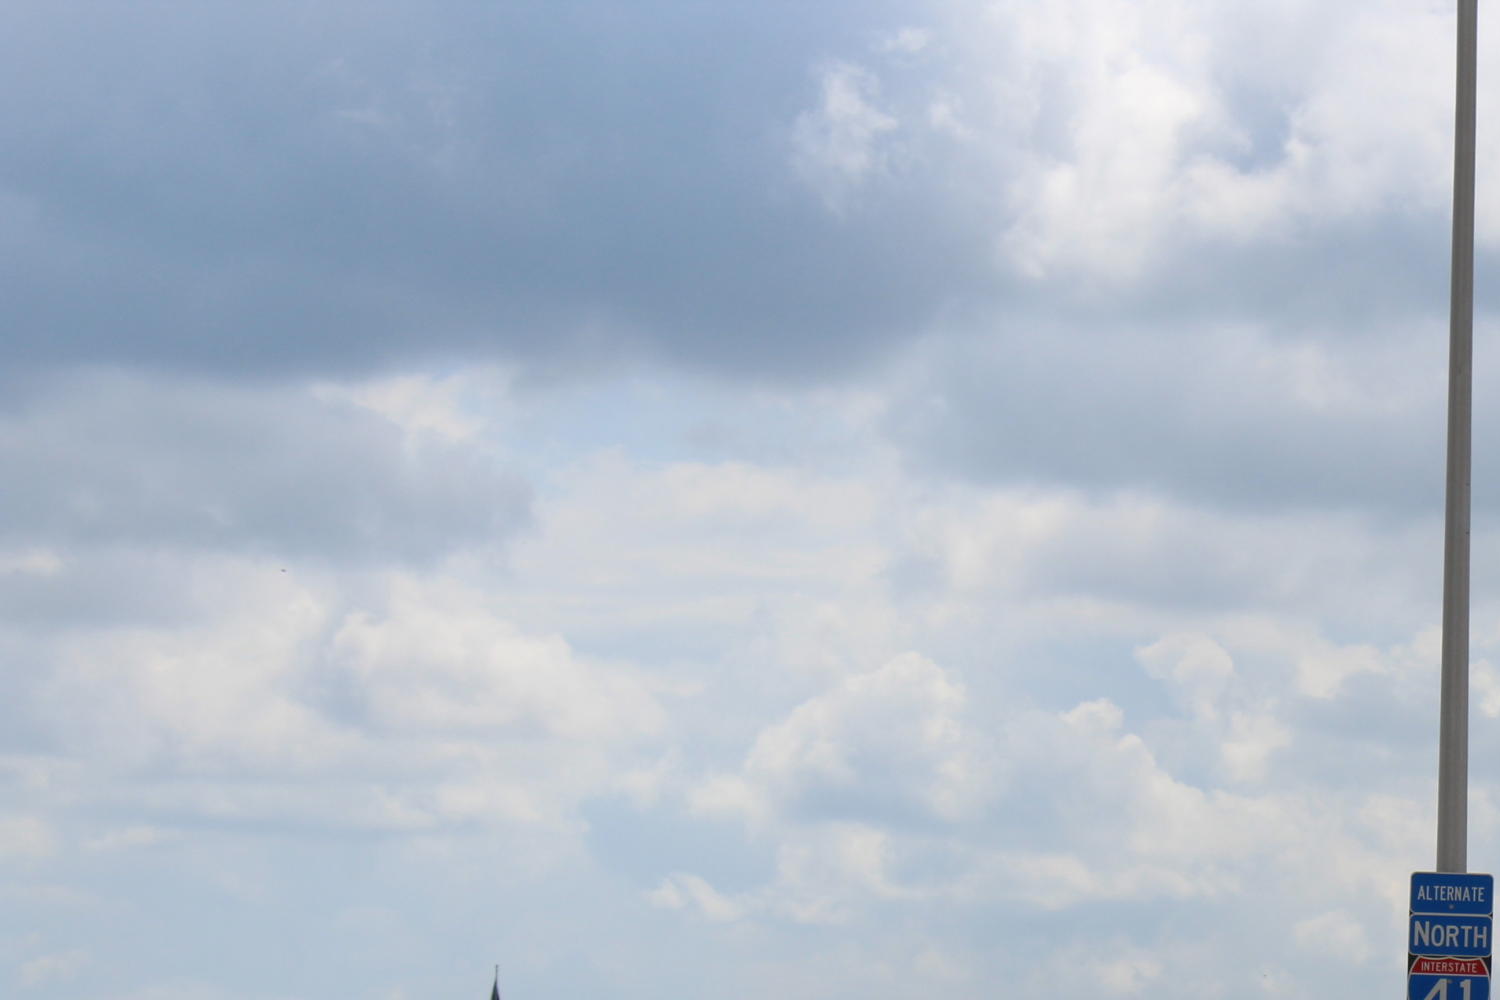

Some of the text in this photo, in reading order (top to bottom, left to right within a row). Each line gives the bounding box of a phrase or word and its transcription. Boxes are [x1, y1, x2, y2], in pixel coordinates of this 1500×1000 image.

[1417, 885, 1485, 902] ALTERNATE
[1413, 920, 1488, 948] NORTH
[1421, 961, 1478, 973] INTERSTATE
